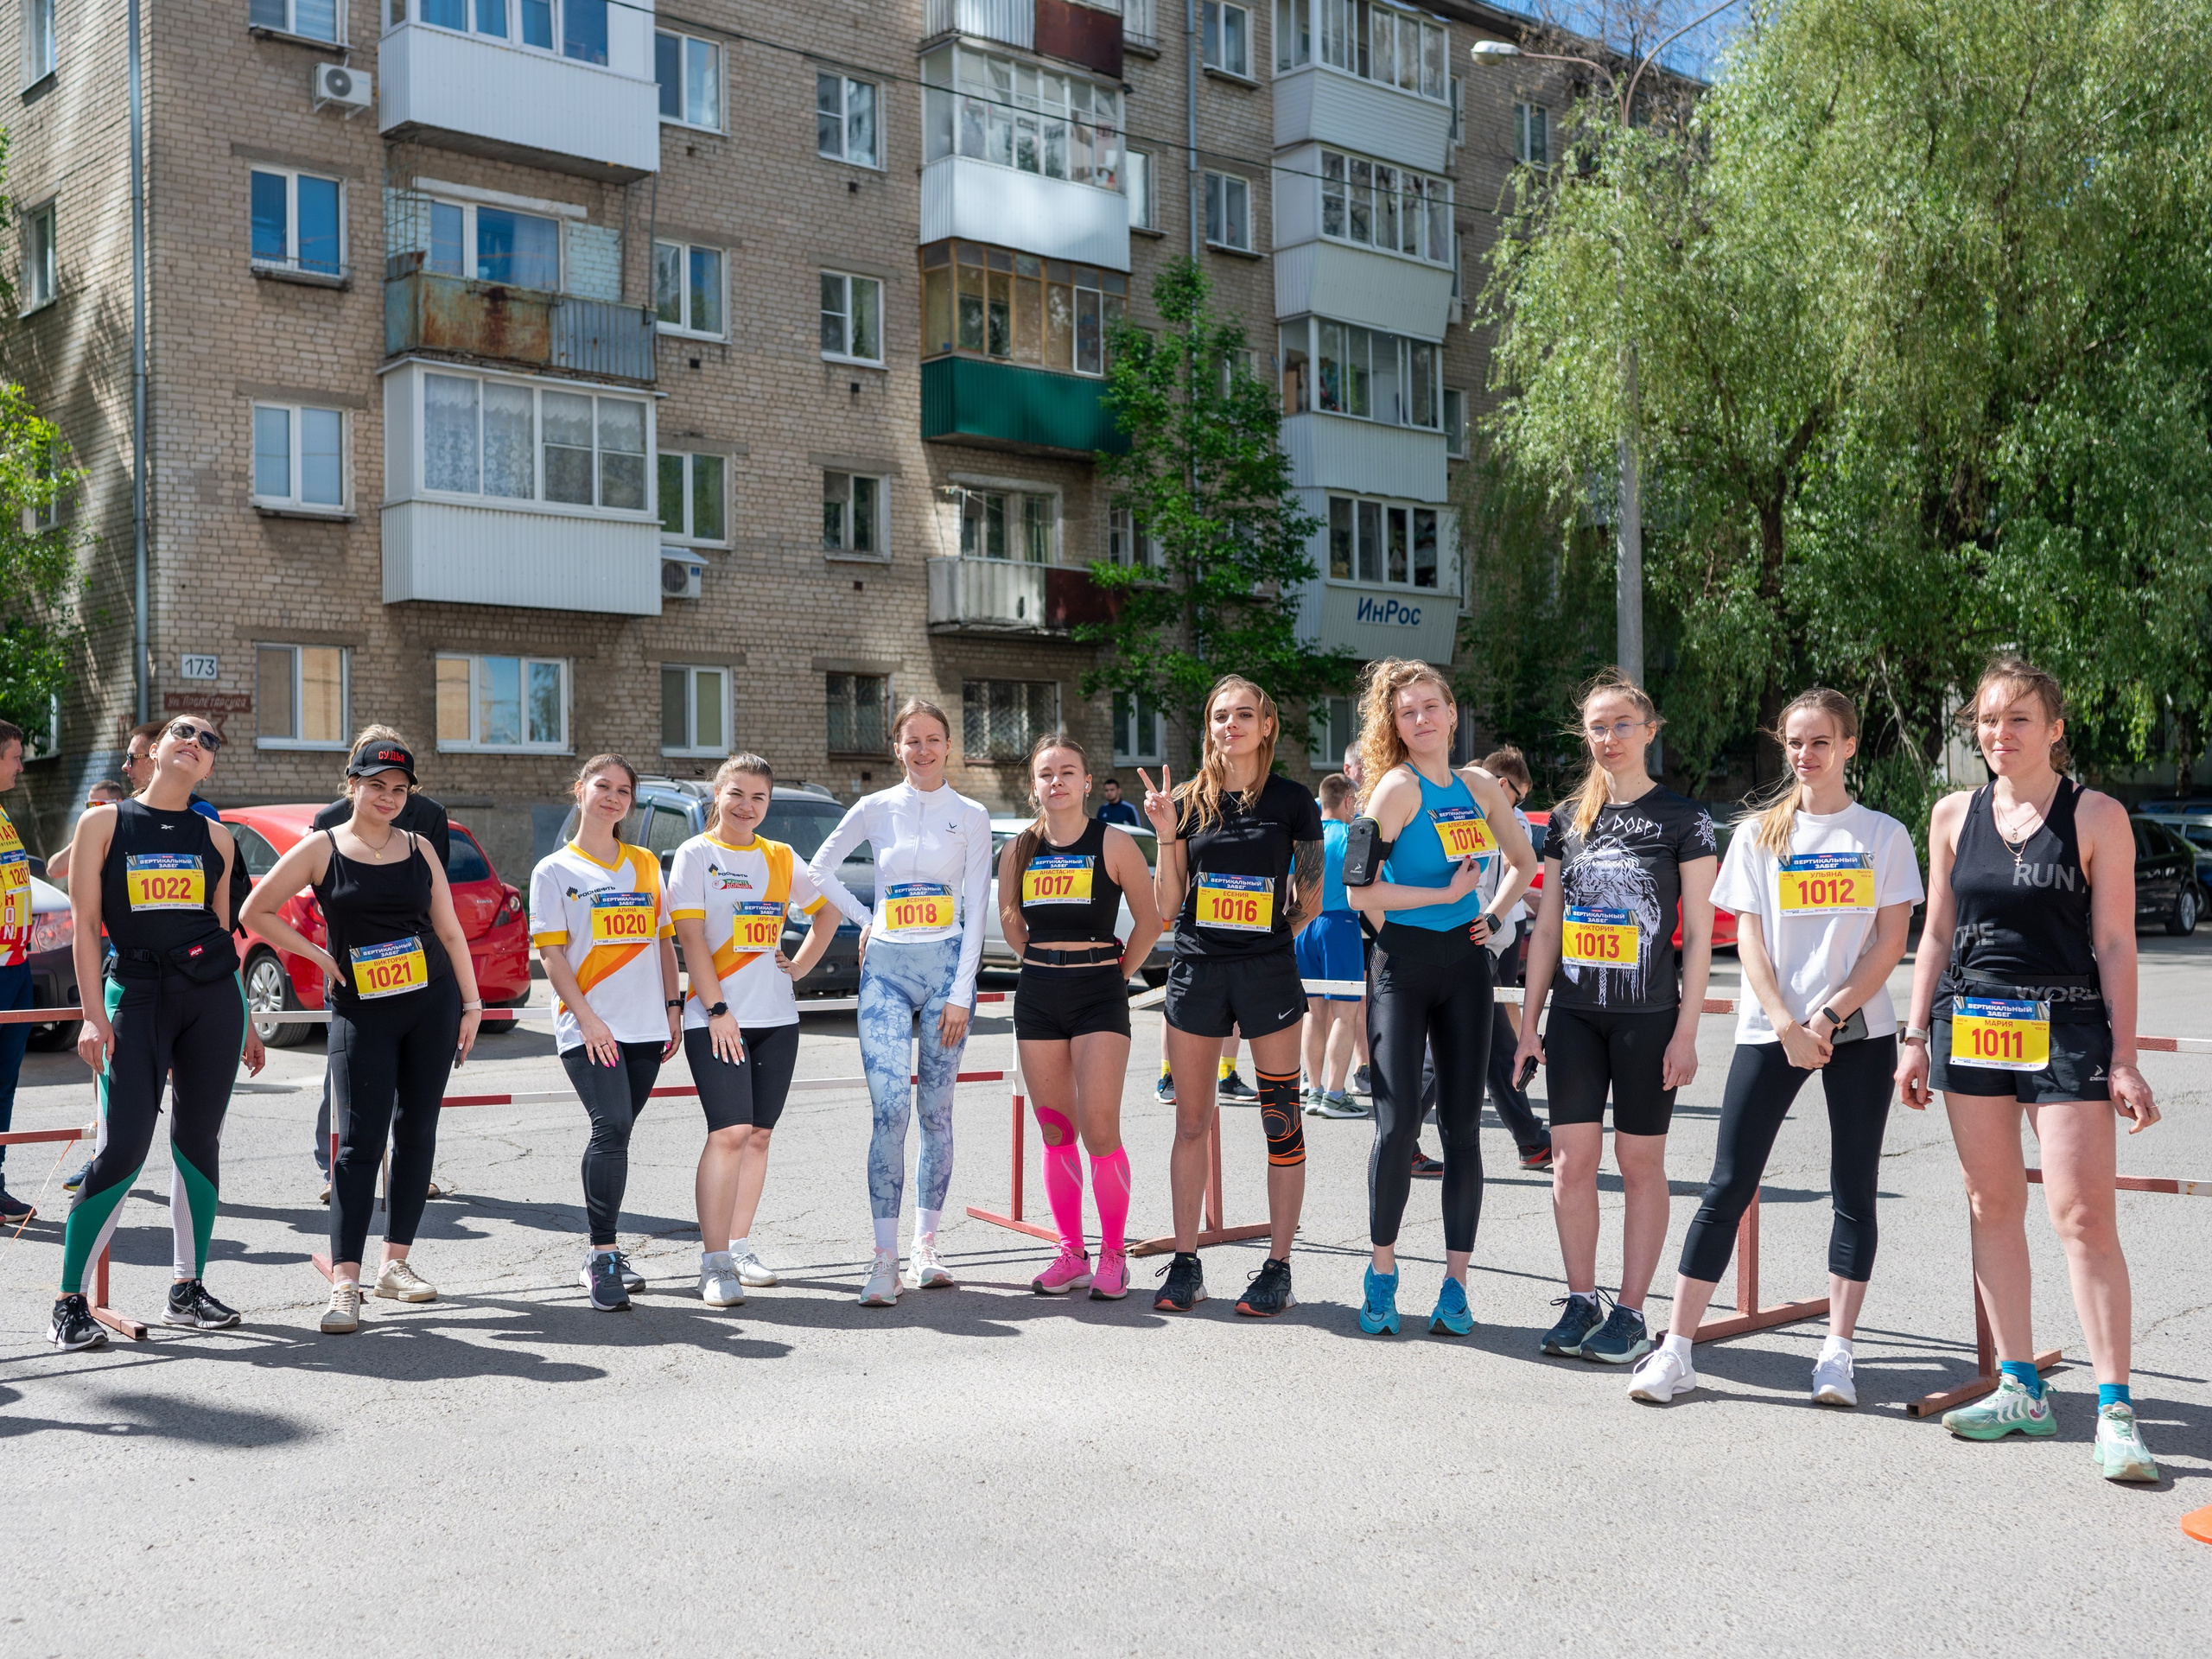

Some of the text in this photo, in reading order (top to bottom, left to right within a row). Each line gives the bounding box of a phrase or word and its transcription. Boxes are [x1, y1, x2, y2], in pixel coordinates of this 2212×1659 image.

[1357, 596, 1421, 625] ИнРос
[185, 658, 215, 676] 173
[378, 750, 405, 763] СУДЬЯ
[1612, 814, 1662, 839] ДОБРУ
[1450, 827, 1485, 850] 1014
[1033, 876, 1073, 896] 1017
[1211, 878, 1262, 887] ВЕРТИКАЛЬНЫЙ
[2013, 862, 2075, 892] RUN
[141, 877, 191, 899] 1022
[577, 887, 615, 899] РОСНЕФТЬ
[1798, 878, 1854, 905] 1012
[895, 904, 937, 925] 1018
[1212, 898, 1257, 922] 1016
[603, 914, 646, 935] 1020
[745, 923, 778, 944] 1019
[363, 942, 412, 956] ВЕРТИКАЛЬНЫЙ
[1576, 932, 1619, 958] 1013
[374, 956, 407, 966] ВИКТОРИЯ
[366, 962, 412, 988] 1021
[1967, 1003, 2032, 1013] ВЕРТИКАЛЬНЫЙ
[1972, 1028, 2022, 1058] 1011
